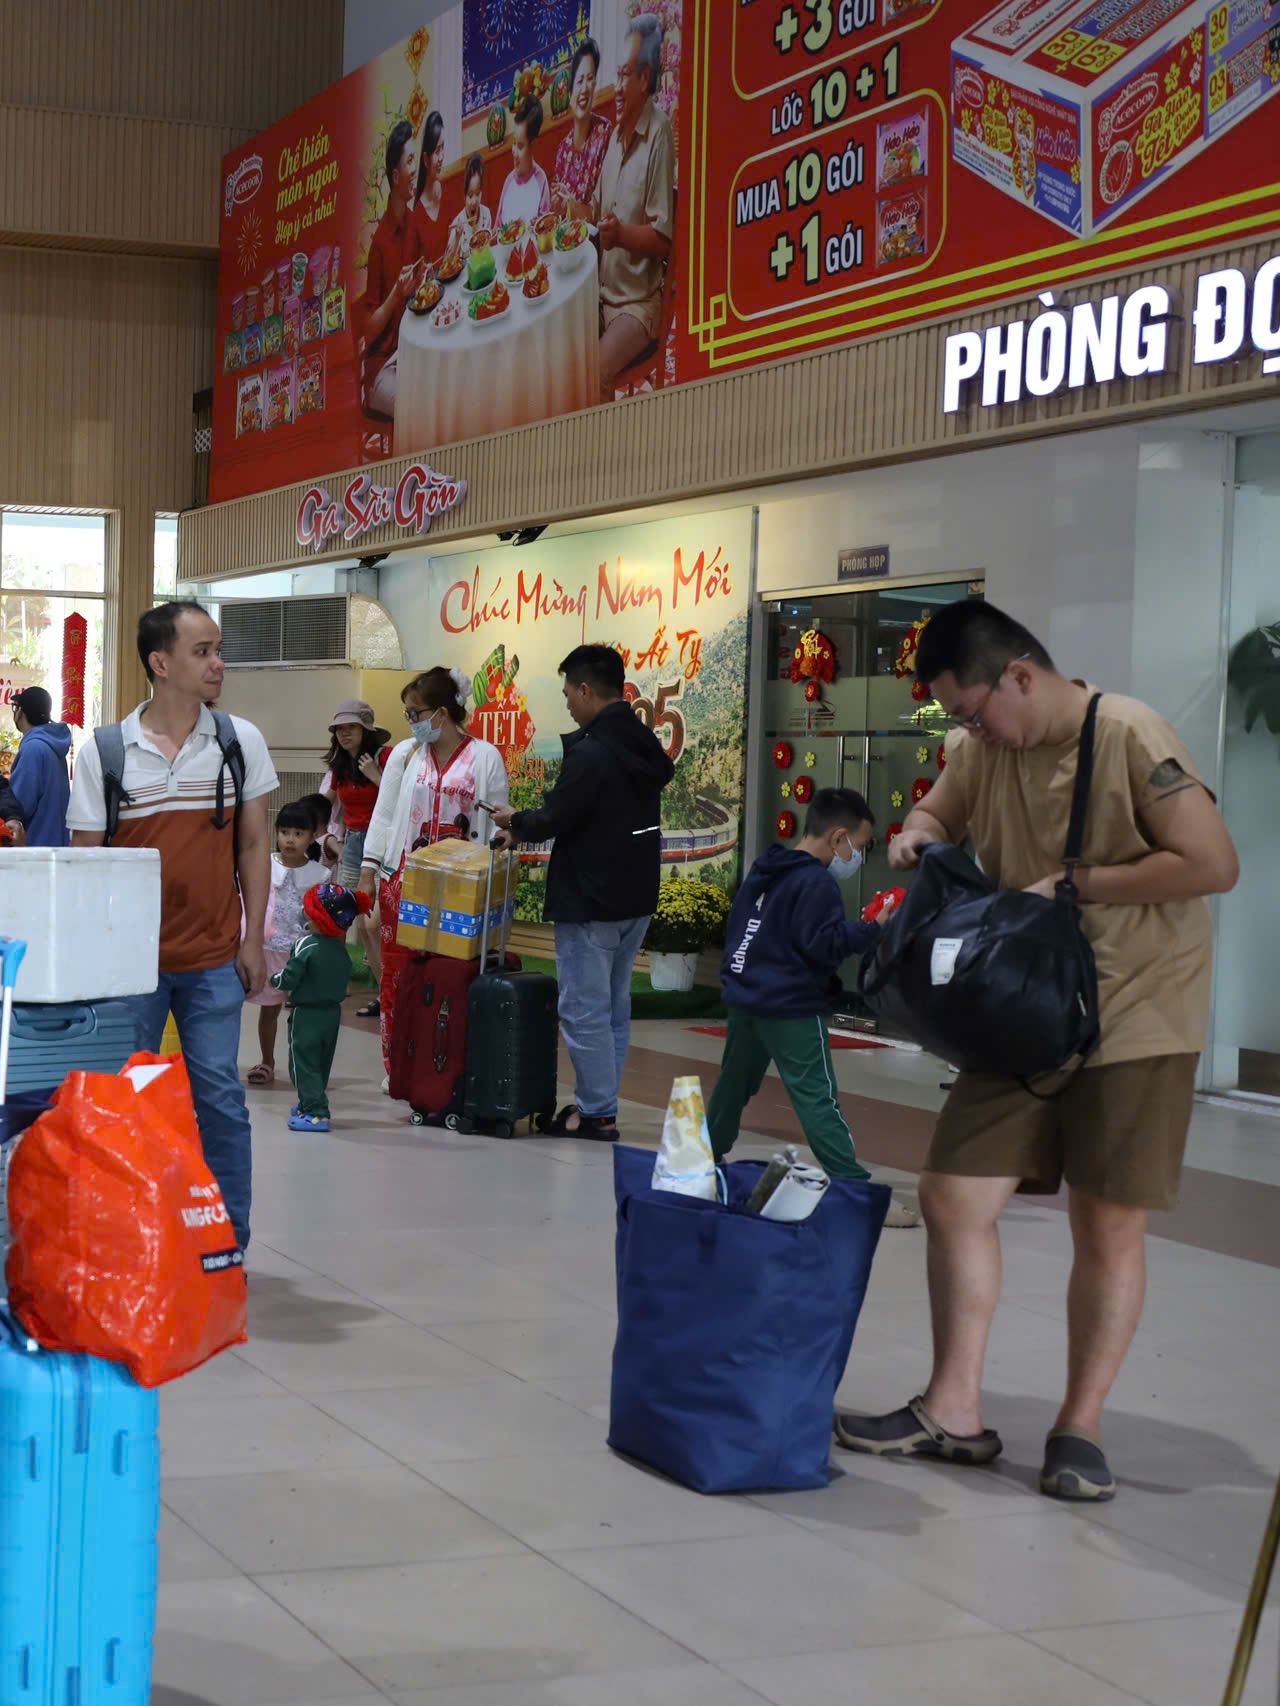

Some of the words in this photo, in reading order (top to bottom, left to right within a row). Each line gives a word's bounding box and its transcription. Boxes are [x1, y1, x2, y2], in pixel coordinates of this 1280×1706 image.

[1048, 31, 1081, 55] 30
[1077, 44, 1111, 67] 03
[771, 92, 803, 135] LỐC
[810, 70, 848, 125] 10
[1209, 68, 1226, 96] 03
[278, 137, 303, 183] Chế
[302, 124, 330, 169] biến
[276, 176, 305, 213] món
[305, 159, 339, 203] ngon
[736, 178, 781, 225] MUA
[785, 152, 821, 208] 10
[826, 141, 864, 193] GÓI
[274, 219, 294, 246] Hợp
[302, 205, 313, 230] cả
[314, 191, 338, 224] nhà!
[825, 223, 863, 274] GÓI
[942, 285, 1170, 414] PHÒNG
[296, 487, 341, 551] Ga
[343, 474, 392, 541] Sài
[393, 463, 462, 534] Gòn
[841, 556, 868, 572] PHÒNG
[869, 554, 886, 571] HỌP
[439, 563, 511, 634] Chúc
[516, 569, 588, 646] Mừng
[672, 546, 733, 609] Mới
[676, 628, 706, 680] Tỵ
[478, 700, 521, 746] TẾT
[755, 892, 766, 912] 4
